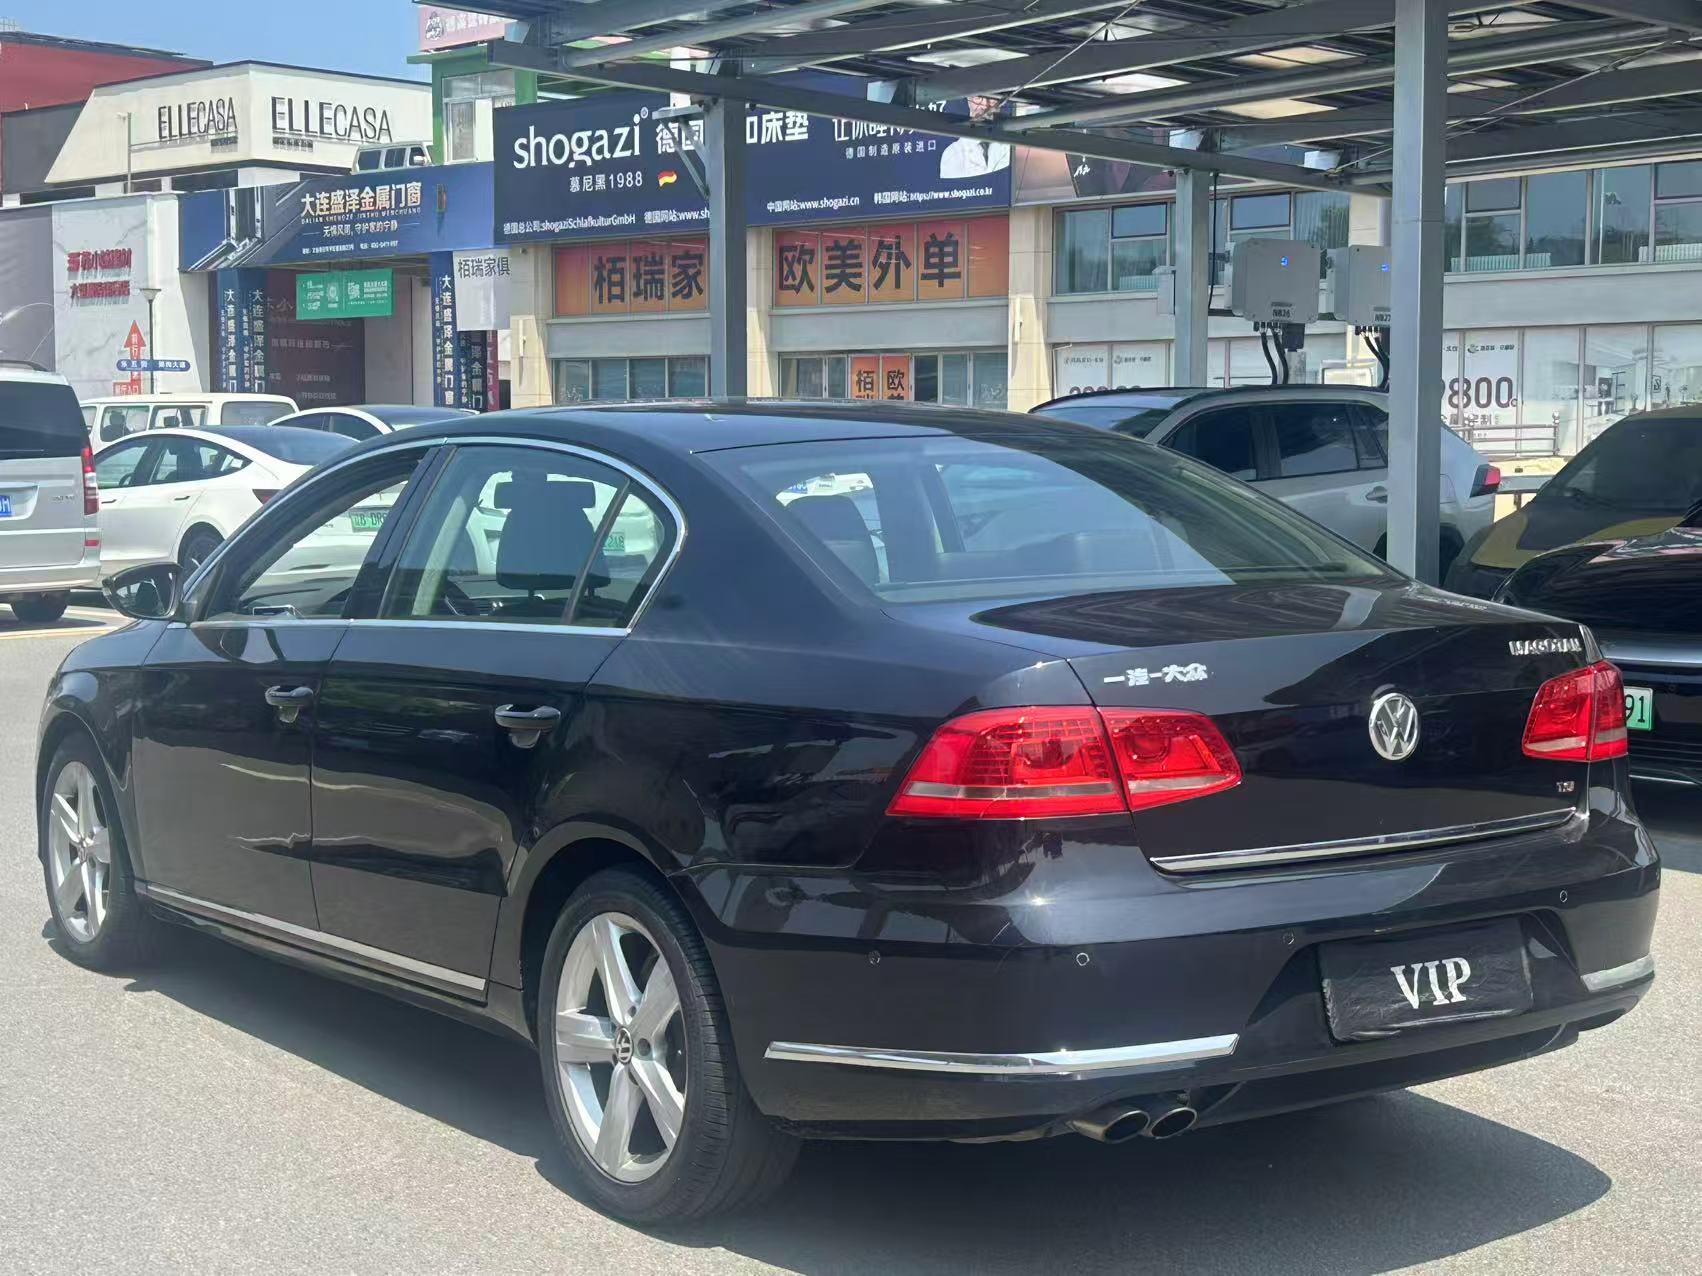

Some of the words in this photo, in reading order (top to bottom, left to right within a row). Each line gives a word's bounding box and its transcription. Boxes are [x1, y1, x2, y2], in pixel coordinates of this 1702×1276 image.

[158, 96, 238, 140] ELLECASA
[271, 96, 393, 142] ELLECASA
[513, 112, 641, 169] shogazi
[301, 182, 422, 217] 大连盛泽金属门窗
[778, 231, 962, 295] 欧美外单
[1390, 957, 1471, 1010] VIP
